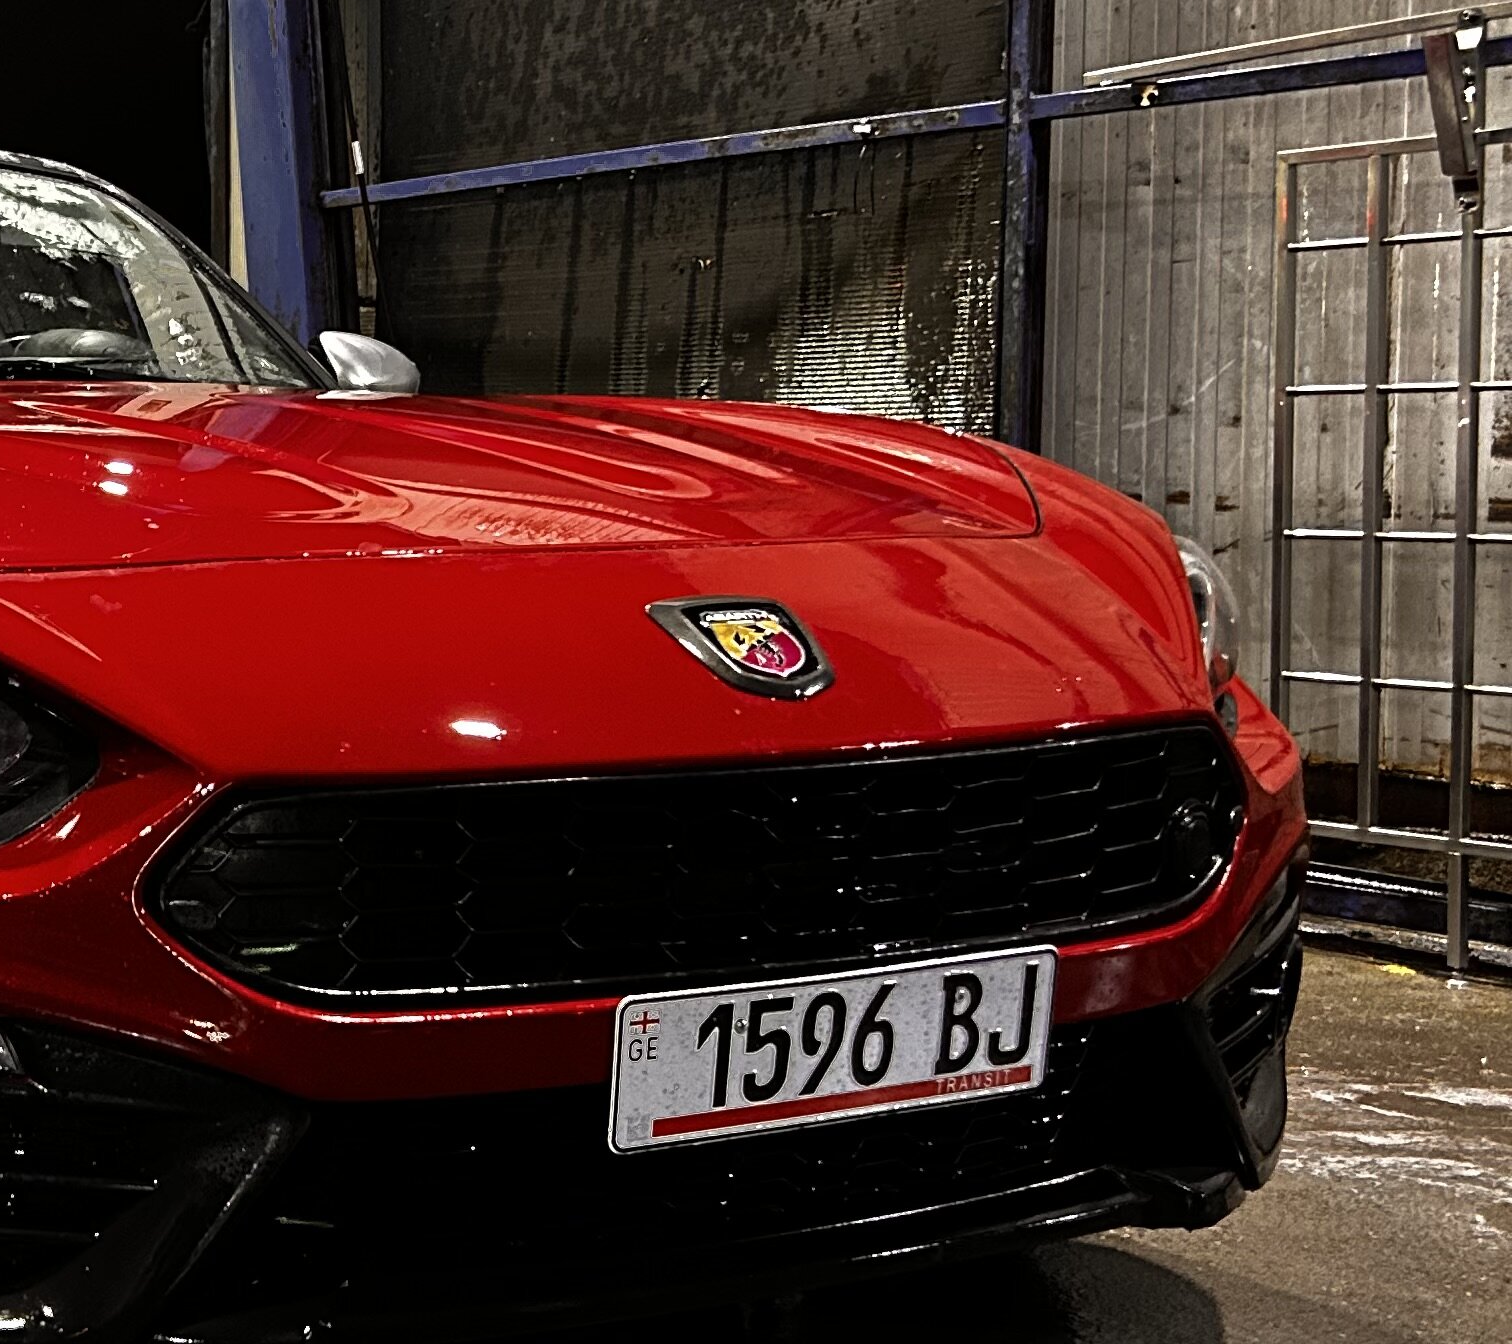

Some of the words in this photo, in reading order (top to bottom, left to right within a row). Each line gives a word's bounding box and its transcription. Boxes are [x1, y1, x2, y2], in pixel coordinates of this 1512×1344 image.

[695, 980, 898, 1109] 1596
[934, 961, 1040, 1076] BJ
[628, 1037, 659, 1062] GE
[936, 1069, 1012, 1095] TRANSIT
